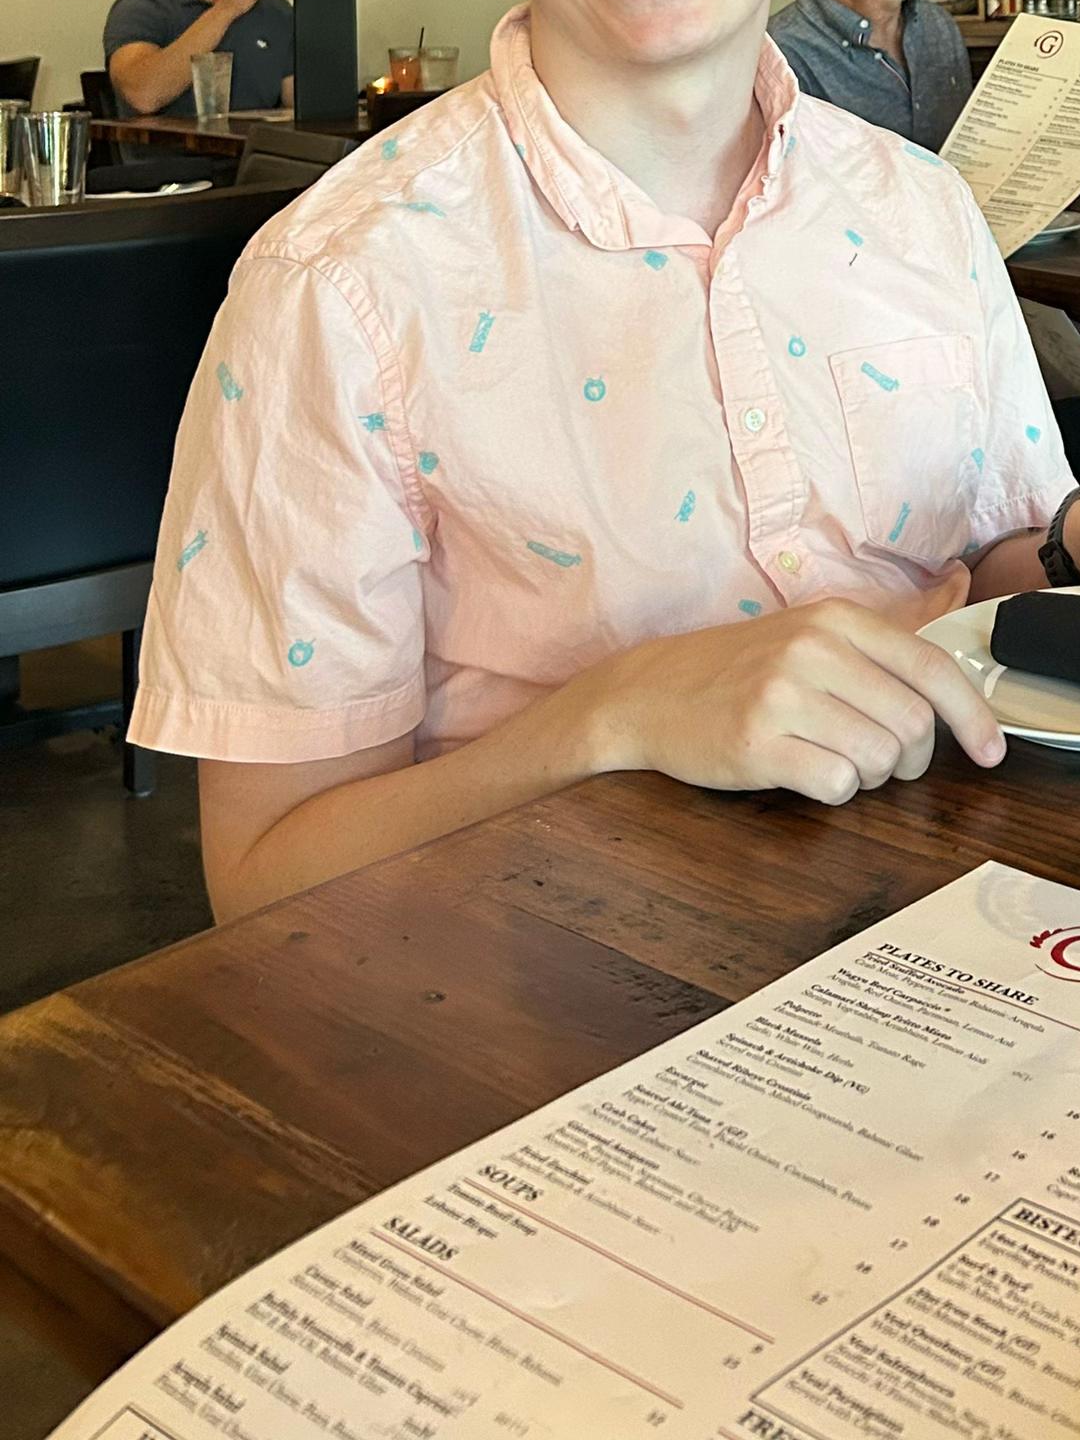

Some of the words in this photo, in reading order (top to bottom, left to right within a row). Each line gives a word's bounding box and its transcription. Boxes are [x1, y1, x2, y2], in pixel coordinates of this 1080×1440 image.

[837, 967, 869, 984] Wagyu
[868, 980, 895, 993] Beef
[891, 989, 942, 1011] Carpaccio
[876, 943, 946, 973] PLATES
[945, 968, 974, 983] TO
[972, 978, 1040, 1006] SHARE
[477, 1165, 543, 1202] SOUPS
[382, 1217, 459, 1260] SALADS
